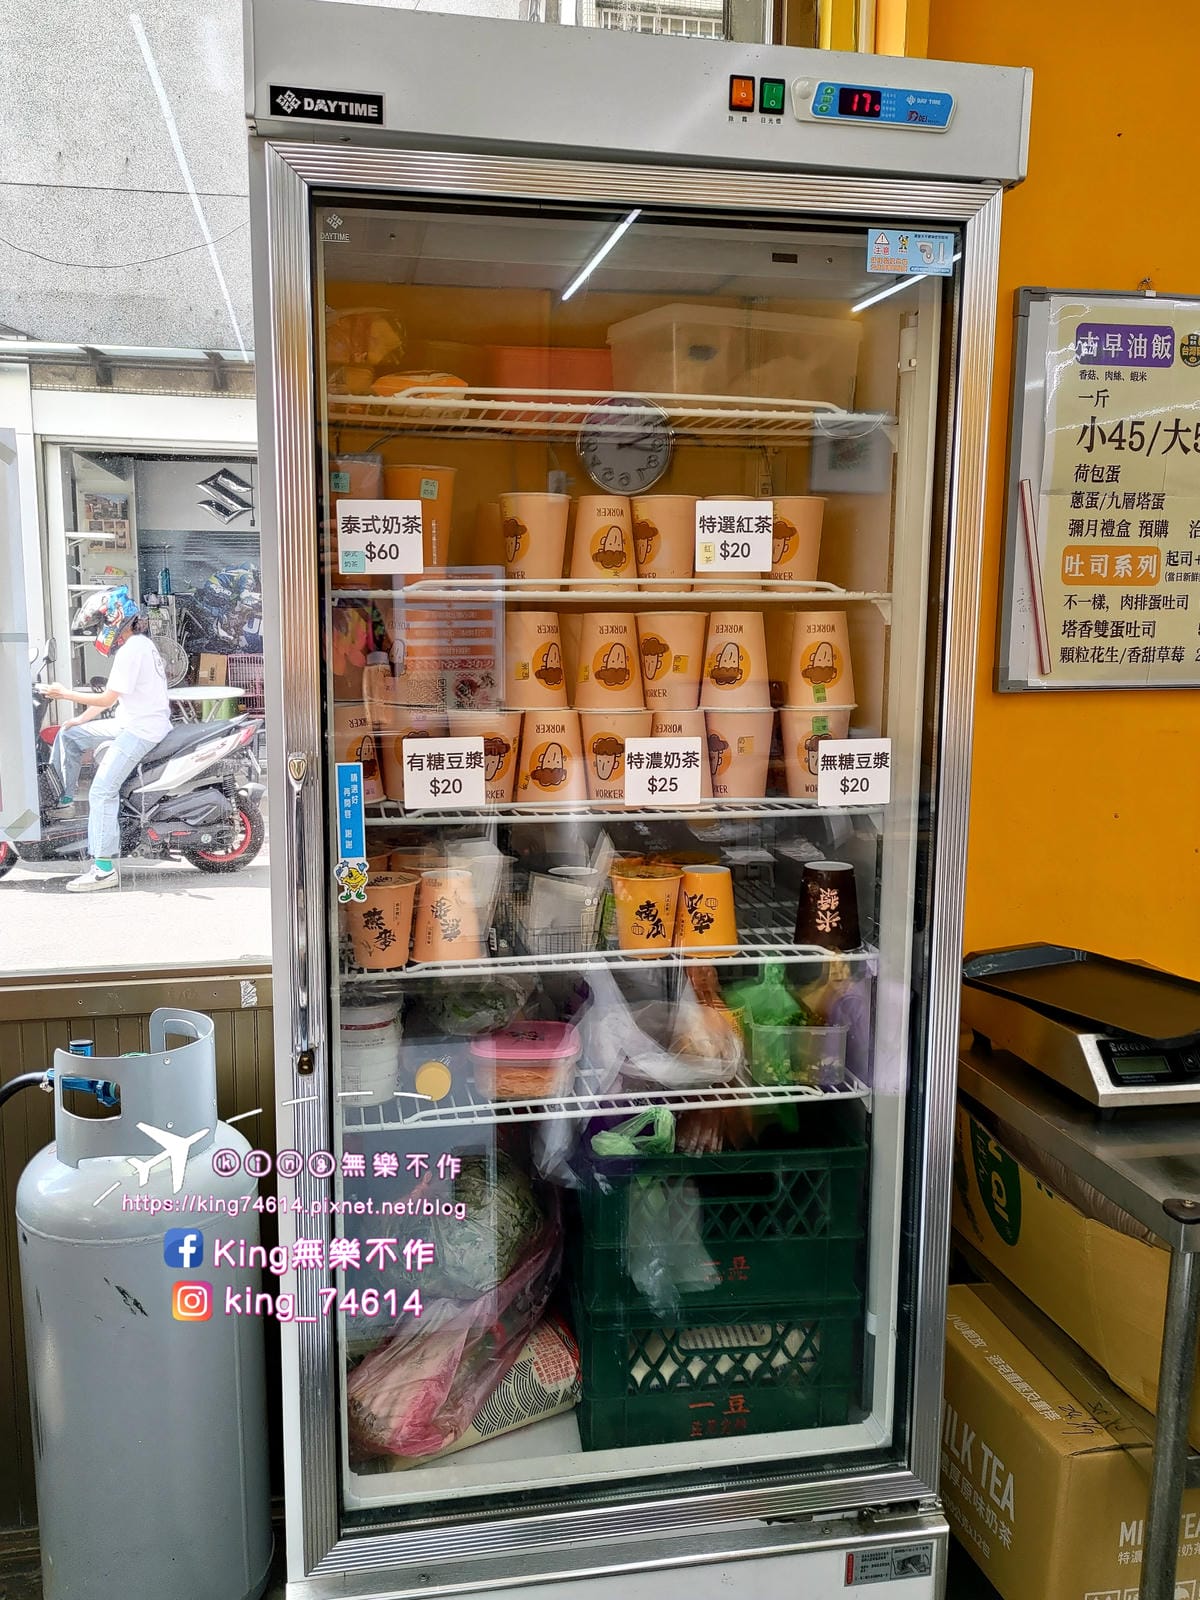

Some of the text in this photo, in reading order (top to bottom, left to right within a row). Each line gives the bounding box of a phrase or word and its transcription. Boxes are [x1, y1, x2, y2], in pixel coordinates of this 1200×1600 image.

[303, 97, 379, 118] DAYTIME
[320, 232, 350, 241] DAYTIME
[1079, 369, 1148, 382] 香菇、肉絲、蝦米
[1078, 388, 1110, 408] 一斤
[1074, 464, 1121, 483] 荷包蛋
[596, 507, 625, 518] WORKER
[341, 515, 422, 535] 泰式奶茶
[699, 515, 772, 535] 特選紅茶
[1068, 519, 1132, 538] 彌月禮盒
[1138, 519, 1169, 538] 預購
[365, 541, 400, 562] $60
[719, 540, 751, 560] $20
[1064, 553, 1158, 579] 吐司系列
[1164, 571, 1200, 583] (當日新鮮
[599, 624, 628, 634] WORKER
[715, 624, 744, 634] WORKER
[806, 624, 836, 634] WORKER
[1061, 620, 1157, 639] 塔香雙蛋吐司
[1060, 646, 1186, 665] 顆粒花生/香甜草莓
[535, 724, 566, 734] WORKER
[655, 723, 683, 733] WORKER
[406, 750, 484, 772] 有糖豆漿
[626, 750, 700, 770] 特濃奶茶
[821, 752, 890, 772] 無糖豆漿
[430, 777, 463, 798] $20
[486, 789, 505, 799] RKER
[595, 789, 624, 799] WORKER
[647, 775, 679, 795] $25
[840, 776, 870, 795] $20
[362, 906, 397, 952] 燕麥
[635, 900, 667, 940] 南瓜
[942, 1402, 1015, 1523] ILK TEA
